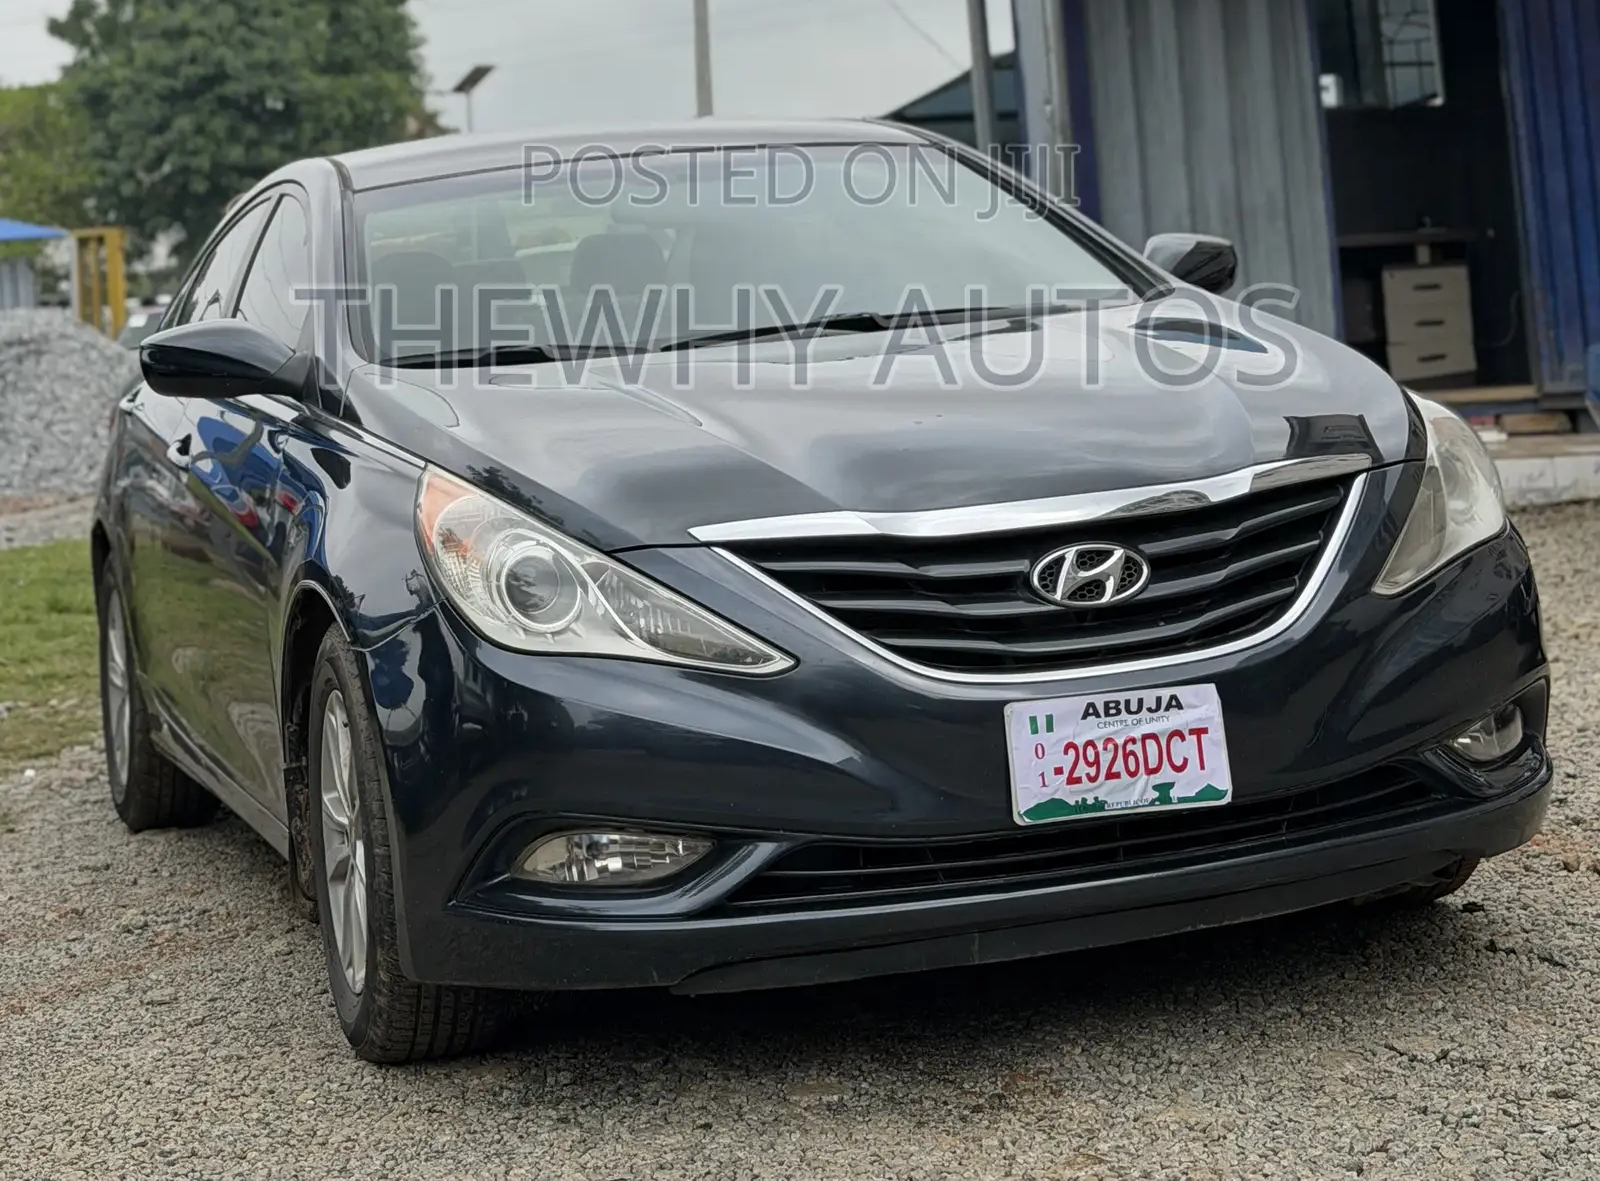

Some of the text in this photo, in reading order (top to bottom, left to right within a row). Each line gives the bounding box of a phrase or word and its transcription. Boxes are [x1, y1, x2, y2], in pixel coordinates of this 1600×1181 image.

[1081, 694, 1184, 720] ABUJA
[1131, 717, 1143, 726] OF
[1145, 715, 1170, 725] UNITY
